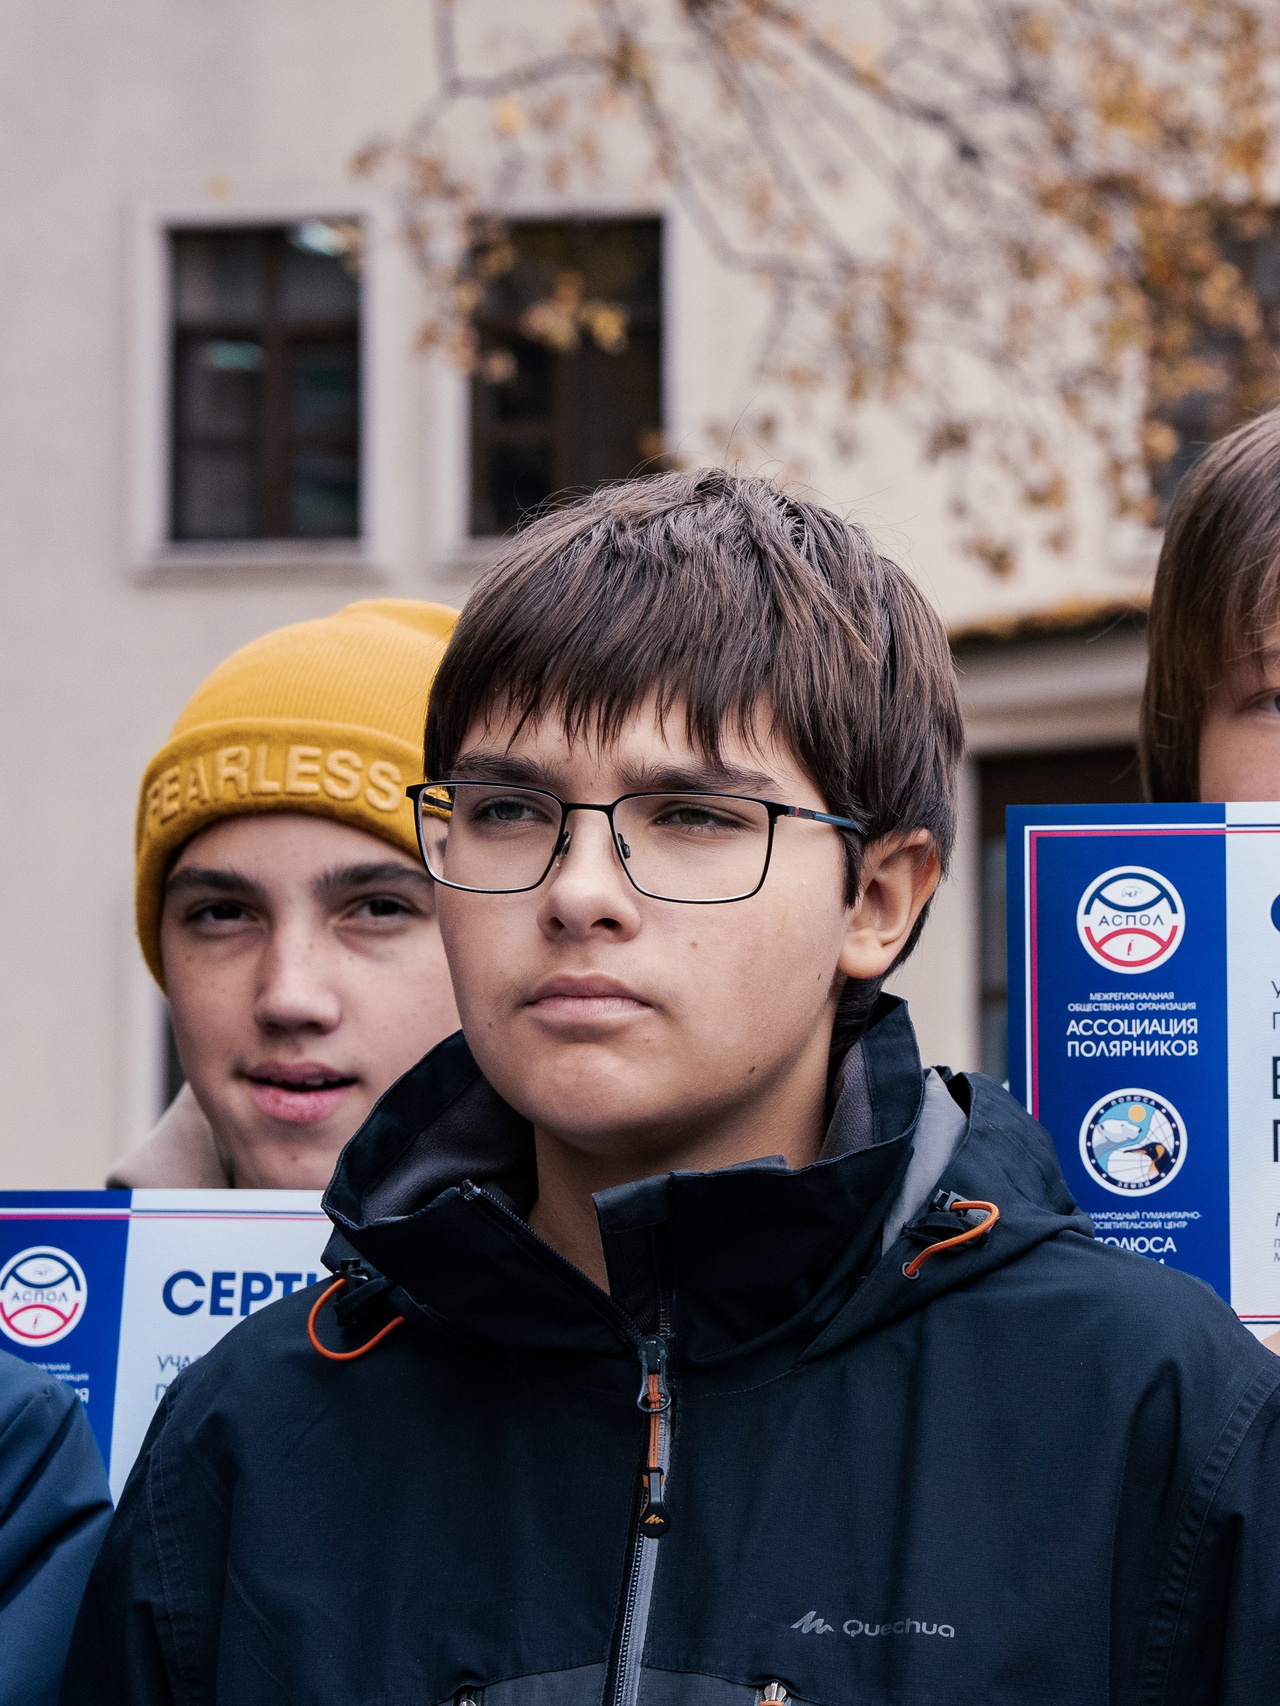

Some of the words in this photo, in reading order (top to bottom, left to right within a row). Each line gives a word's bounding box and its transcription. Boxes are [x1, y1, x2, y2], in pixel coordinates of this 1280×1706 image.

[145, 744, 404, 832] FEARLESS
[1098, 914, 1164, 926] АСПОЛ
[1066, 1018, 1198, 1037] АССОЦИАЦИЯ
[1067, 1039, 1199, 1057] ПОЛЯРНИКОВ
[11, 1290, 69, 1303] АСПОЛ
[843, 1619, 955, 1639] Quechua
